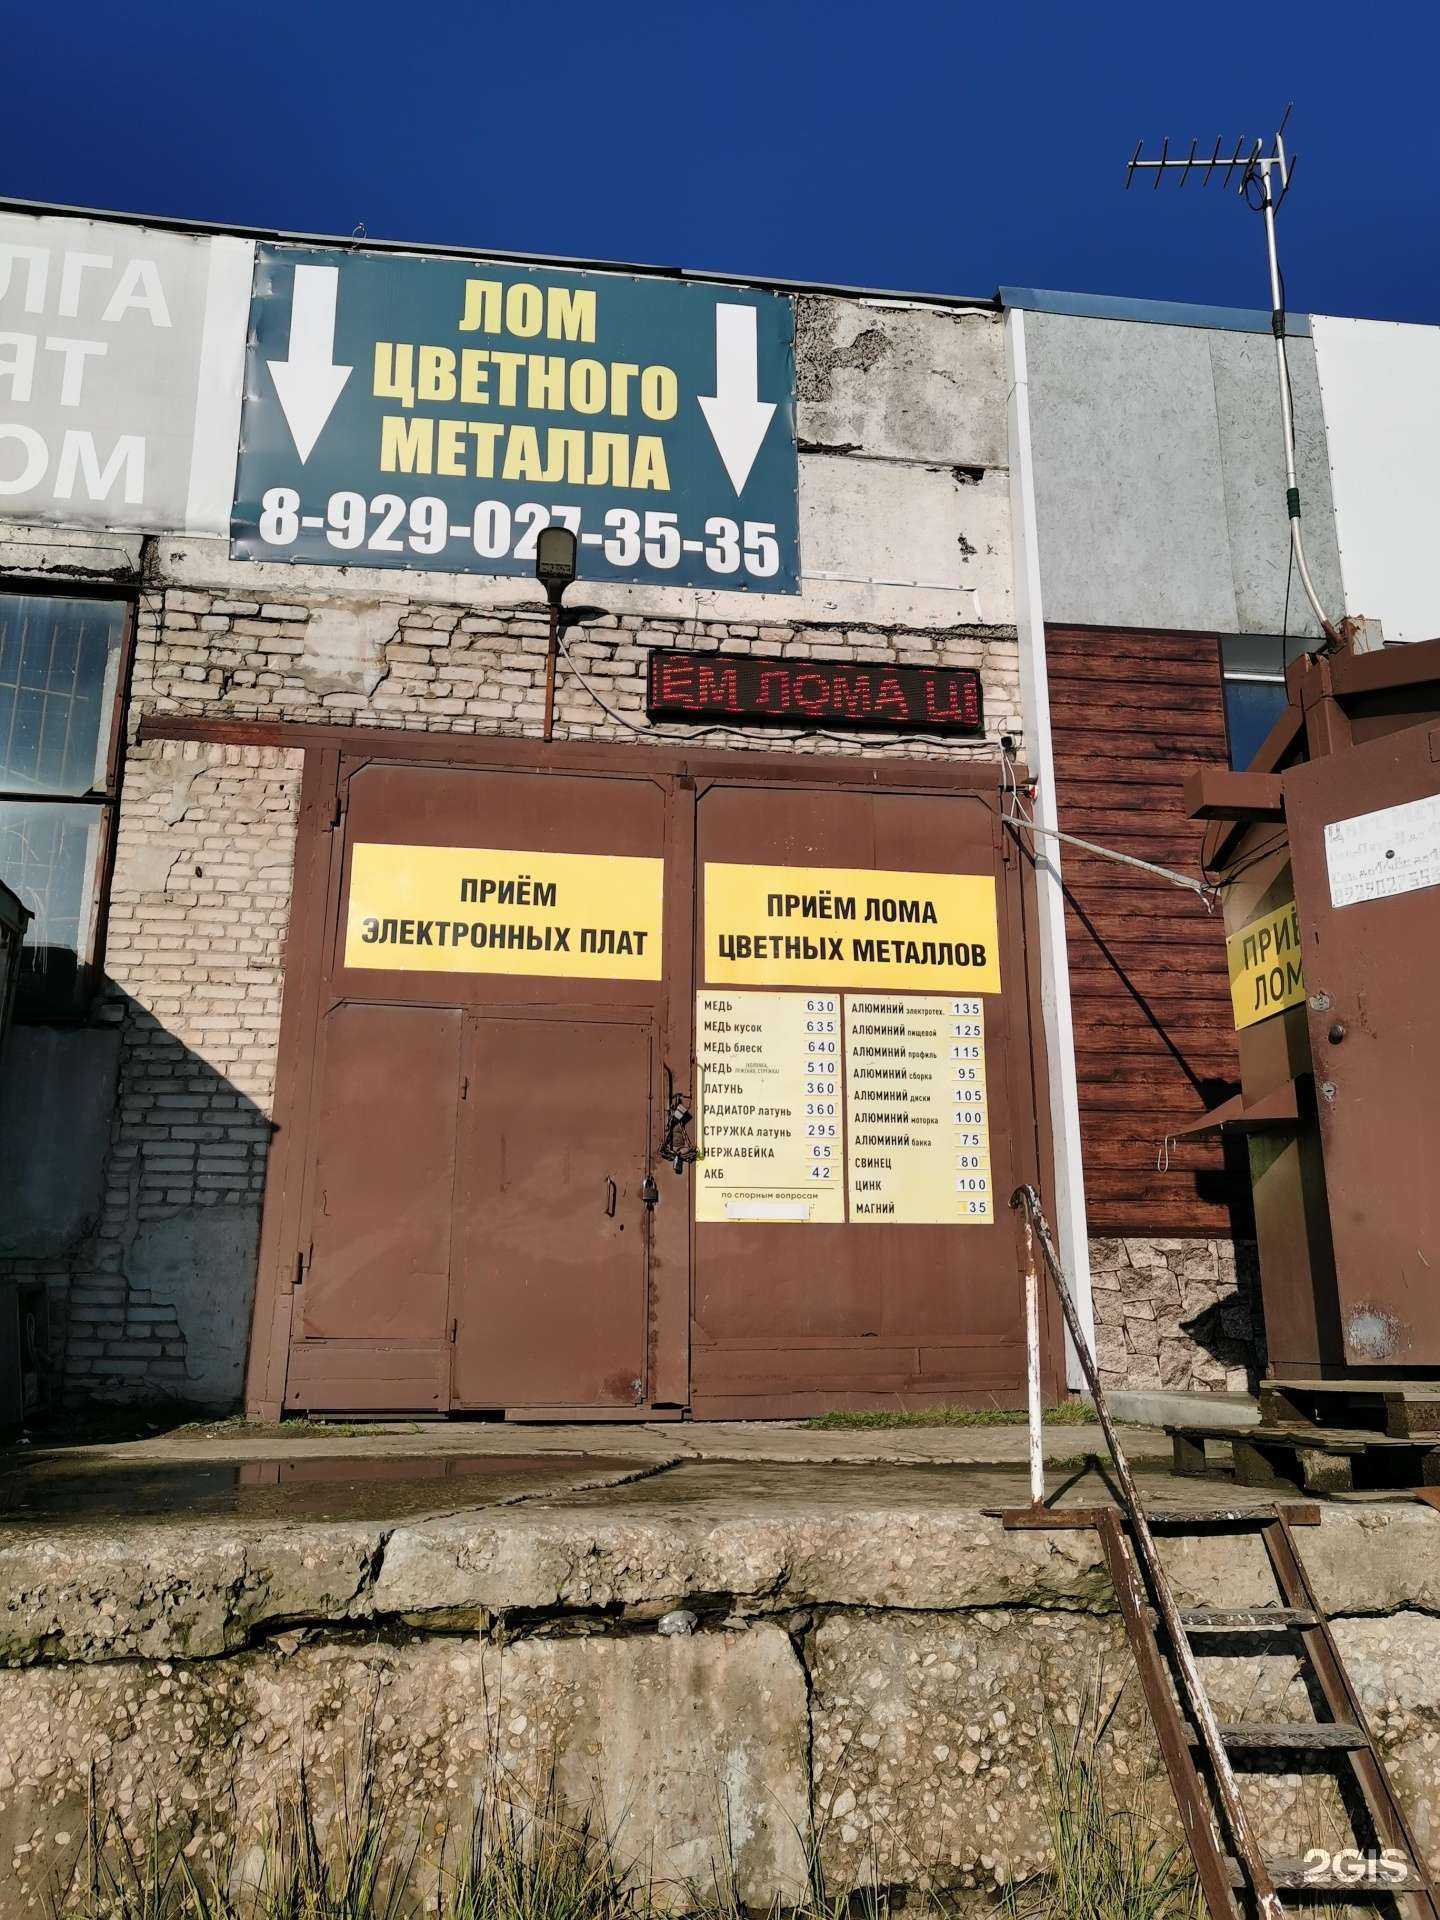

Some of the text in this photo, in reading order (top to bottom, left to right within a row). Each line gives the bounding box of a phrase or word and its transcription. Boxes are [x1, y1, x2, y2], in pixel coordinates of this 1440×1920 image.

[459, 279, 597, 343] ЛОМ
[373, 342, 678, 421] ЦВЕТНОГО
[380, 415, 671, 491] МЕТАЛЛА
[755, 671, 909, 714] ЛОМА
[460, 874, 557, 907] ПРИЁМ
[767, 890, 938, 923] ПРИЁМ ЛОМА
[361, 917, 648, 955] ЭЛЕКТРОННЫХ ПЛАТ
[718, 934, 987, 967] ЦВЕТНЫХ МЕТАЛЛОВ
[704, 1000, 834, 1012] МЕДЬ 630
[852, 1003, 904, 1014] АЛЮМИНИЙ
[954, 1003, 979, 1014] 135
[704, 1021, 834, 1034] МЕДЬ кусок 635
[852, 1024, 980, 1037] АЛЮМИНИЙ пищевой 125
[703, 1042, 835, 1053] МЕДЬ блеск 640
[853, 1045, 979, 1059] АЛЮМИНИЙ профиль 115
[703, 1063, 732, 1074] МЕДЬ
[807, 1062, 835, 1073] 510
[853, 1067, 975, 1081] АЛЮМИНИЙ сборка 95
[703, 1083, 834, 1094] ЛАТУНЬ 360
[854, 1089, 908, 1101] АЛЮМИНИЙ
[956, 1091, 981, 1101] 105
[703, 1104, 834, 1117] РАДИАТОР латунь 360
[854, 1111, 909, 1123] АЛЮМИНИЙ
[956, 1112, 981, 1123] 100
[703, 1125, 835, 1139] СТРУЖКА латунь 295
[855, 1134, 910, 1146] АЛЮМИНИЙ
[962, 1135, 979, 1145] 75
[703, 1146, 831, 1158] НЕРЖАВЕЙКА 65
[855, 1157, 978, 1169] СВИНЕЦ 80
[704, 1168, 830, 1179] АКБ 42
[855, 1179, 986, 1192] ЦИНК 100
[734, 1192, 773, 1200] спорным
[856, 1201, 986, 1214] МАГНИЙ 35
